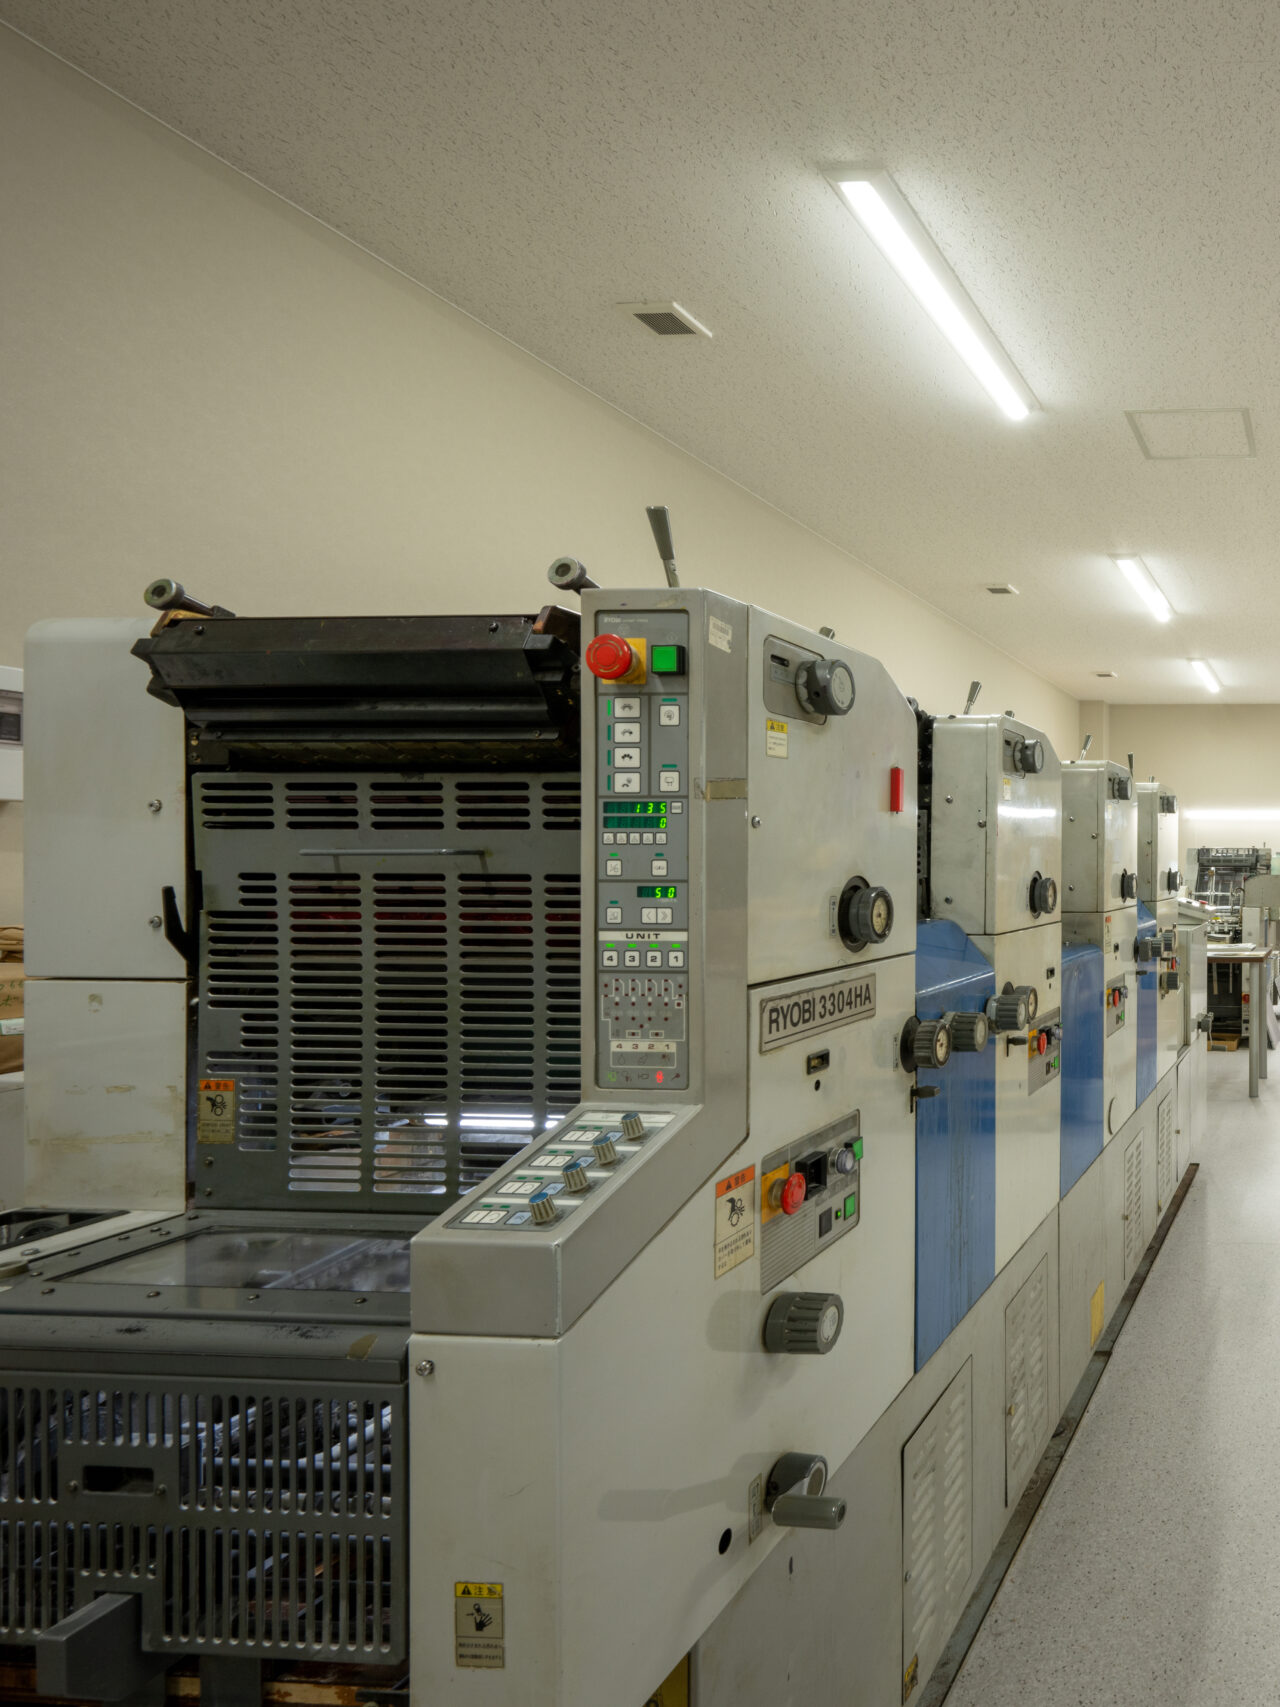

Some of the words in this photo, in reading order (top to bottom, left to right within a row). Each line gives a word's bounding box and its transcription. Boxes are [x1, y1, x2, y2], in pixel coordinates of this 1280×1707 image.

[659, 817, 667, 829] 0
[655, 887, 675, 899] 50
[768, 997, 816, 1035] RYOBI
[818, 983, 872, 1019] 3304HA
